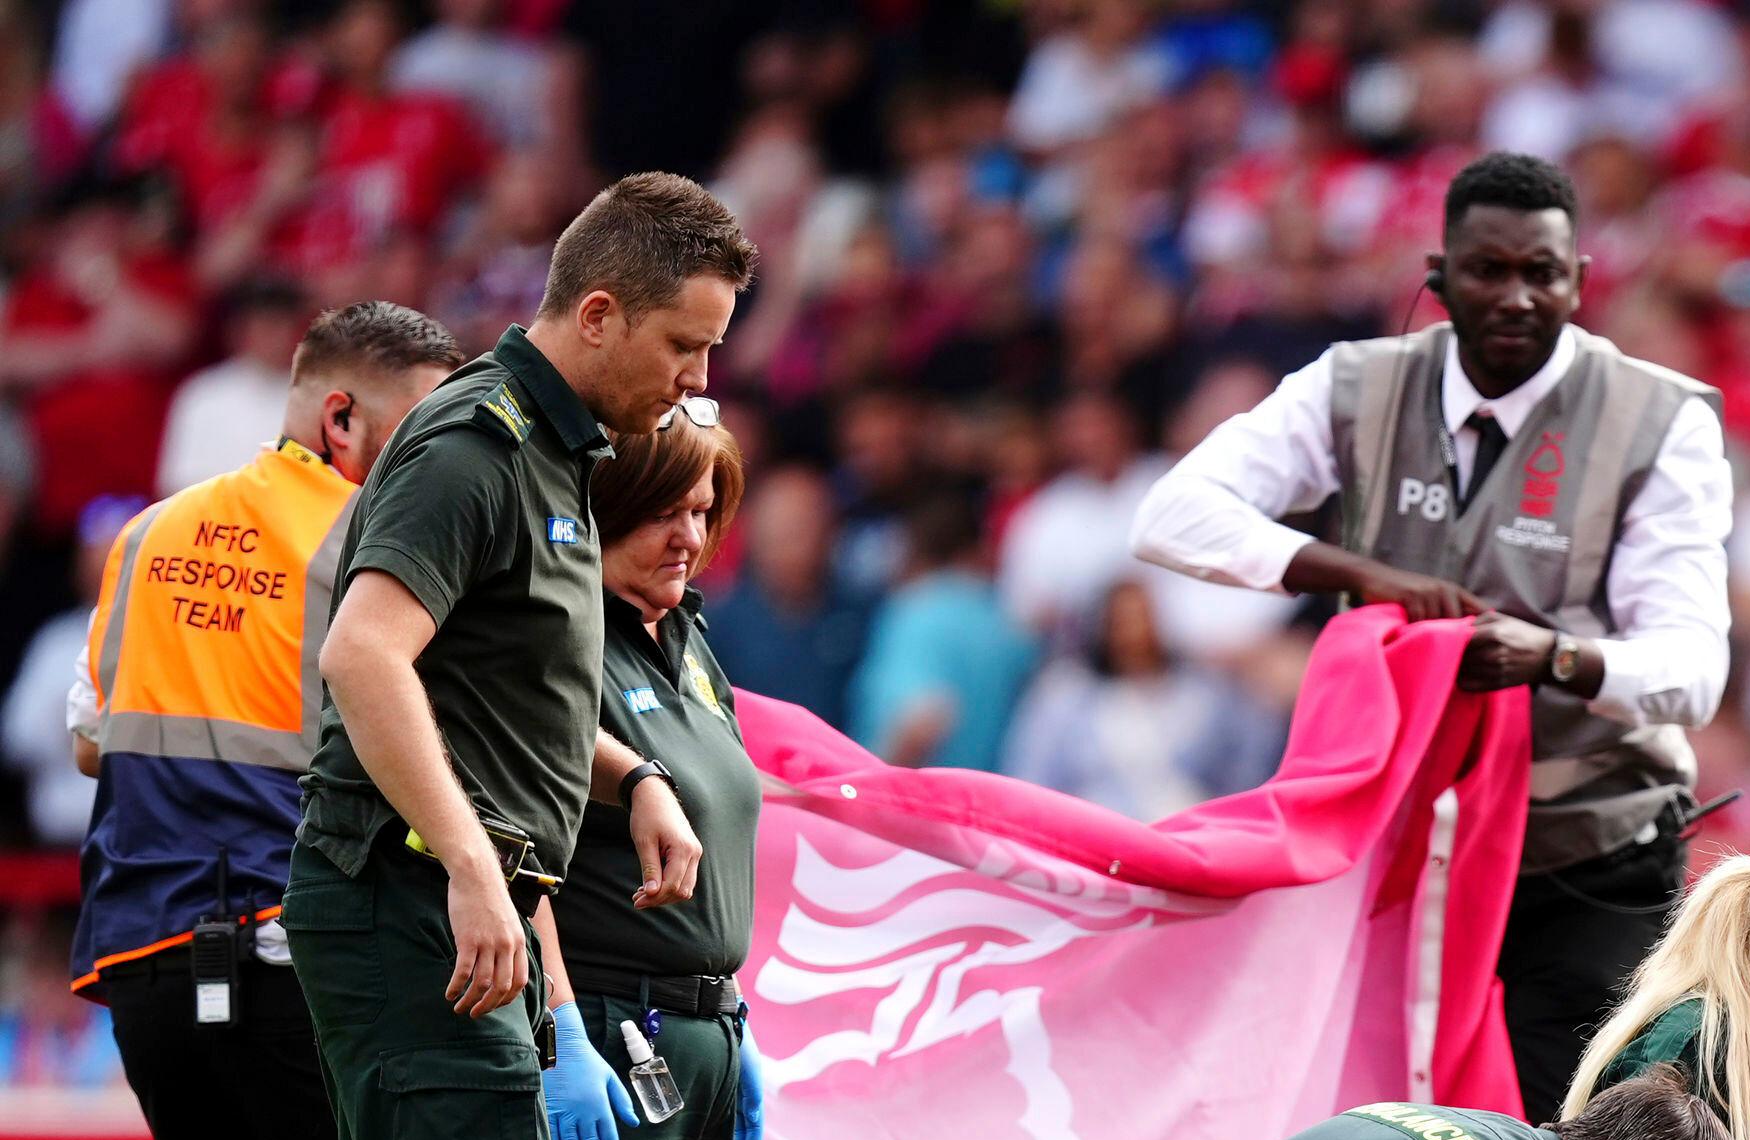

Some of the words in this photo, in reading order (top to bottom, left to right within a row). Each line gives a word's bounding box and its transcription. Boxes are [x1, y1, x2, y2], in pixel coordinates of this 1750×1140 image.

[1397, 477, 1449, 522] P8
[194, 521, 260, 554] NFFC
[551, 519, 575, 541] NHS
[147, 557, 287, 600] RESPONSE
[172, 596, 246, 632] TEAM
